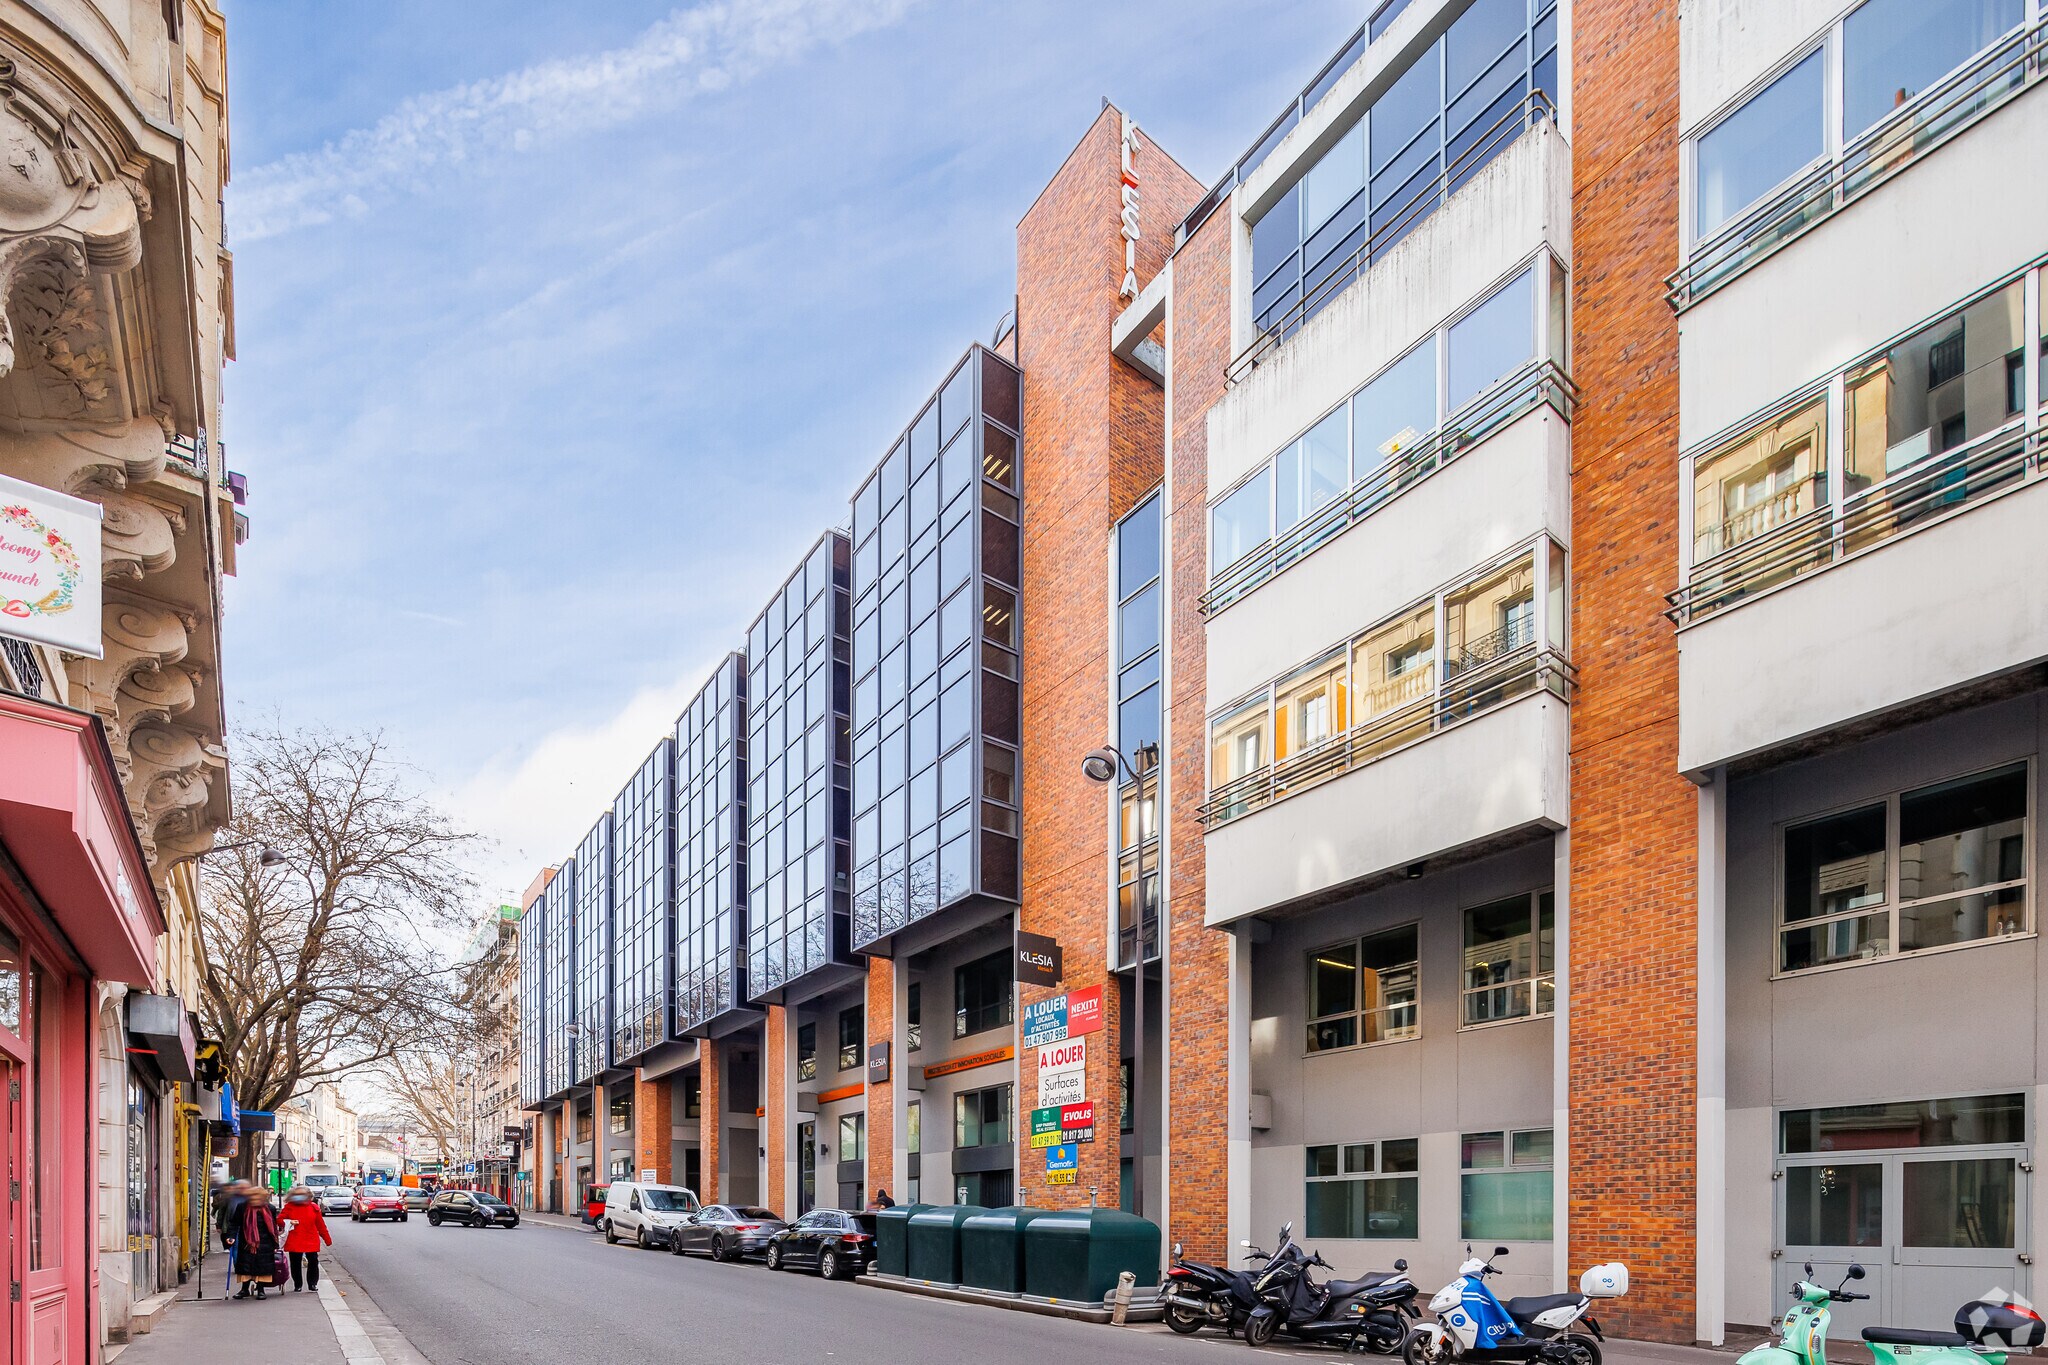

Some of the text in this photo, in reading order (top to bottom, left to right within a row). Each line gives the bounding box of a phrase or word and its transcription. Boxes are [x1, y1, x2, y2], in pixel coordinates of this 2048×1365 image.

[0, 535, 43, 564] loomy
[0, 569, 40, 587] unch
[1025, 1006, 1032, 1020] A
[1034, 995, 1067, 1017] LOUER
[1071, 998, 1099, 1014] NEXITY
[1035, 1013, 1055, 1025] LOCAUX
[1025, 1027, 1067, 1047] 01 47 907 999
[958, 1056, 983, 1068] INNOVATION
[983, 1050, 1006, 1062] SOCIALES
[1040, 1045, 1084, 1068] A LOUER
[1044, 1075, 1079, 1091] Surfaces
[1042, 1090, 1082, 1106] d'activités
[1064, 1109, 1092, 1121] EVOLIS
